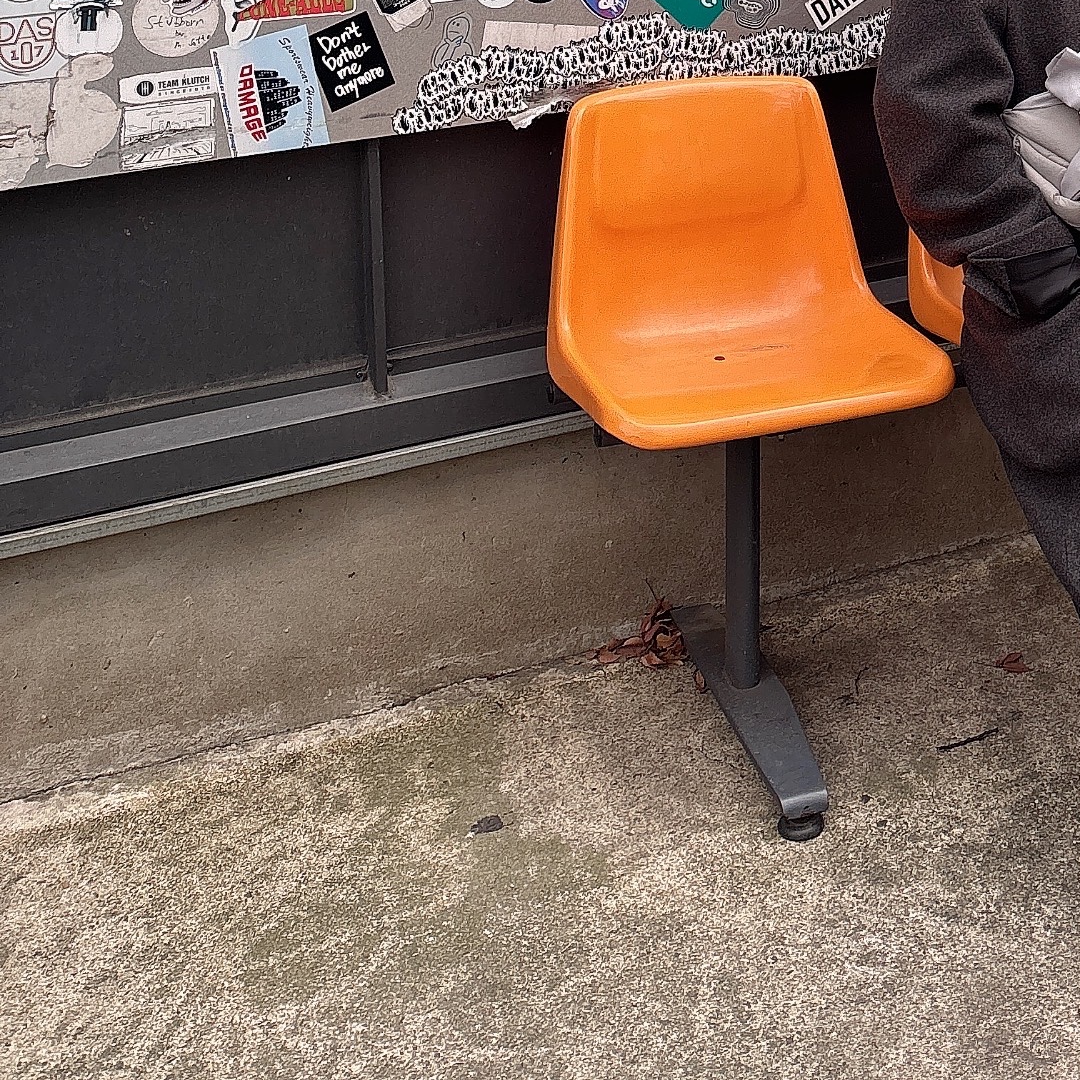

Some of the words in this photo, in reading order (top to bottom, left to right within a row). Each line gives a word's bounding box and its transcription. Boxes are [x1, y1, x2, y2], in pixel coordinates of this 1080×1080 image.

[157, 79, 180, 89] TEAM
[181, 75, 211, 87] KLUTCH
[333, 65, 385, 98] anymore
[336, 62, 362, 81] me
[238, 64, 268, 143] DAMAGE
